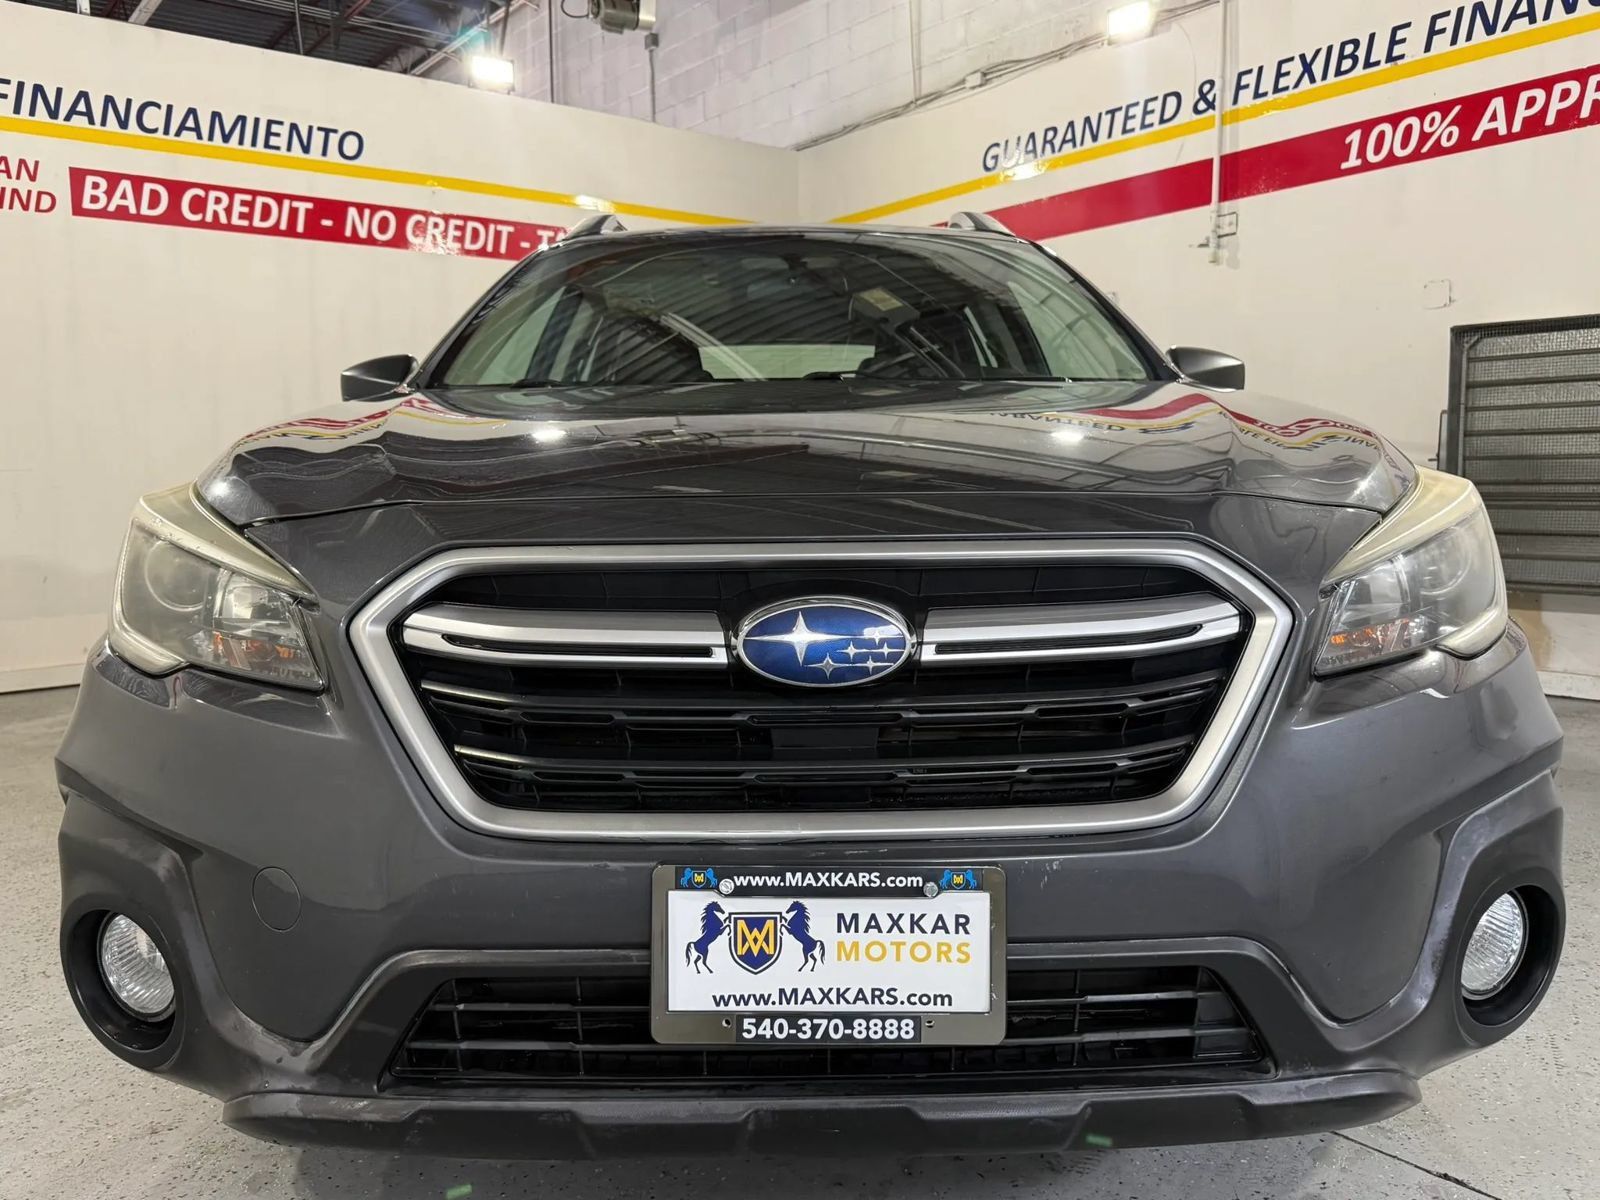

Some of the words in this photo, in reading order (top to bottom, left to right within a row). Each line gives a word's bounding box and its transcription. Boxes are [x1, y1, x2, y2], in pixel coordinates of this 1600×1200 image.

[982, 90, 1182, 173] GUARANTEED
[1192, 79, 1217, 116] &
[1231, 21, 1412, 106] FLEXIBLE
[1423, 0, 1600, 54] FINAN
[1340, 104, 1462, 170] 100%
[81, 175, 169, 217] BAD
[180, 187, 314, 233] CREDIT
[344, 206, 397, 242] NO
[405, 213, 515, 255] CREDIT
[733, 871, 923, 888] www.MAXKARS.com
[836, 912, 971, 935] MAXKAR
[836, 939, 972, 965] MOTORS
[712, 987, 953, 1008] www.MAXKARS.com
[741, 1017, 915, 1040] 540-370-8888
